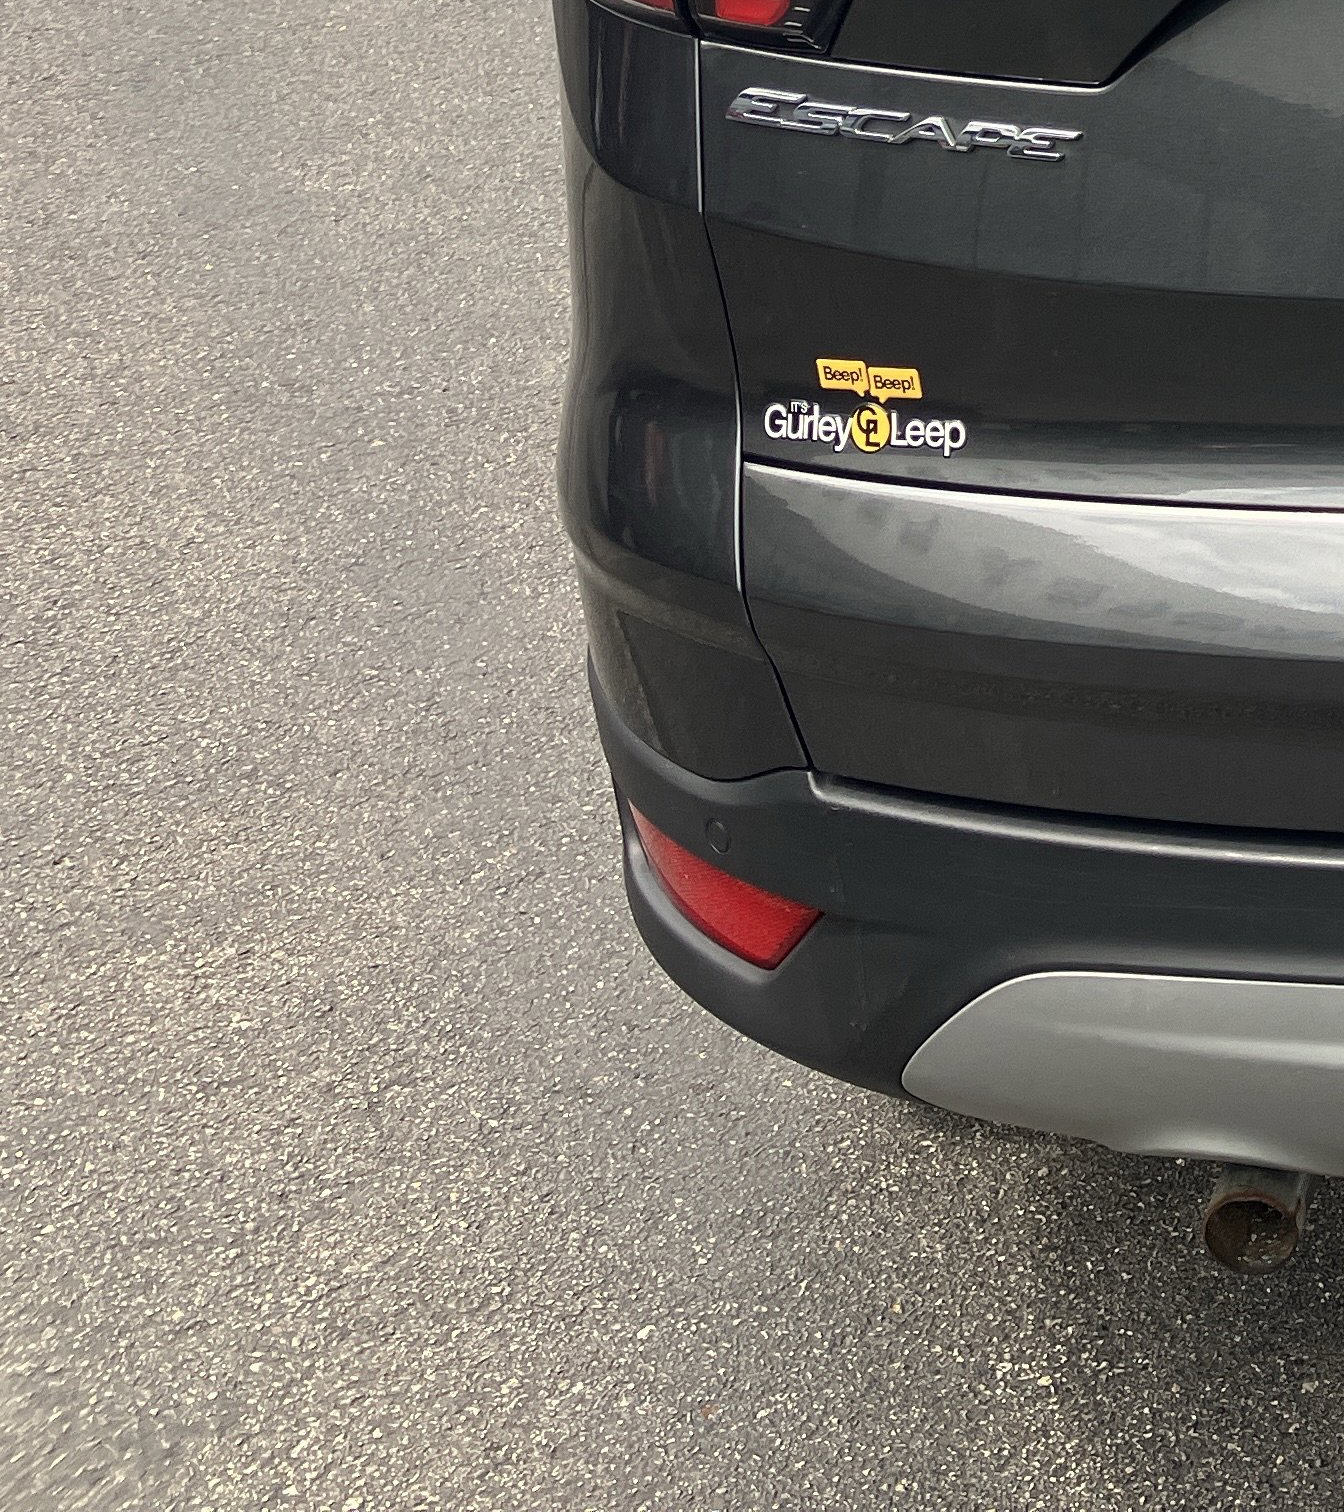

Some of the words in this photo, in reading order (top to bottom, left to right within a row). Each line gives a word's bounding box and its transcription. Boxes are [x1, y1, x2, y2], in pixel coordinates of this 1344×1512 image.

[725, 87, 1084, 162] ESCAPE
[822, 365, 864, 385] Beep!
[873, 375, 916, 393] Beep!
[790, 401, 810, 414] IT'S
[764, 402, 854, 453] Gurley
[890, 410, 967, 457] Leep
